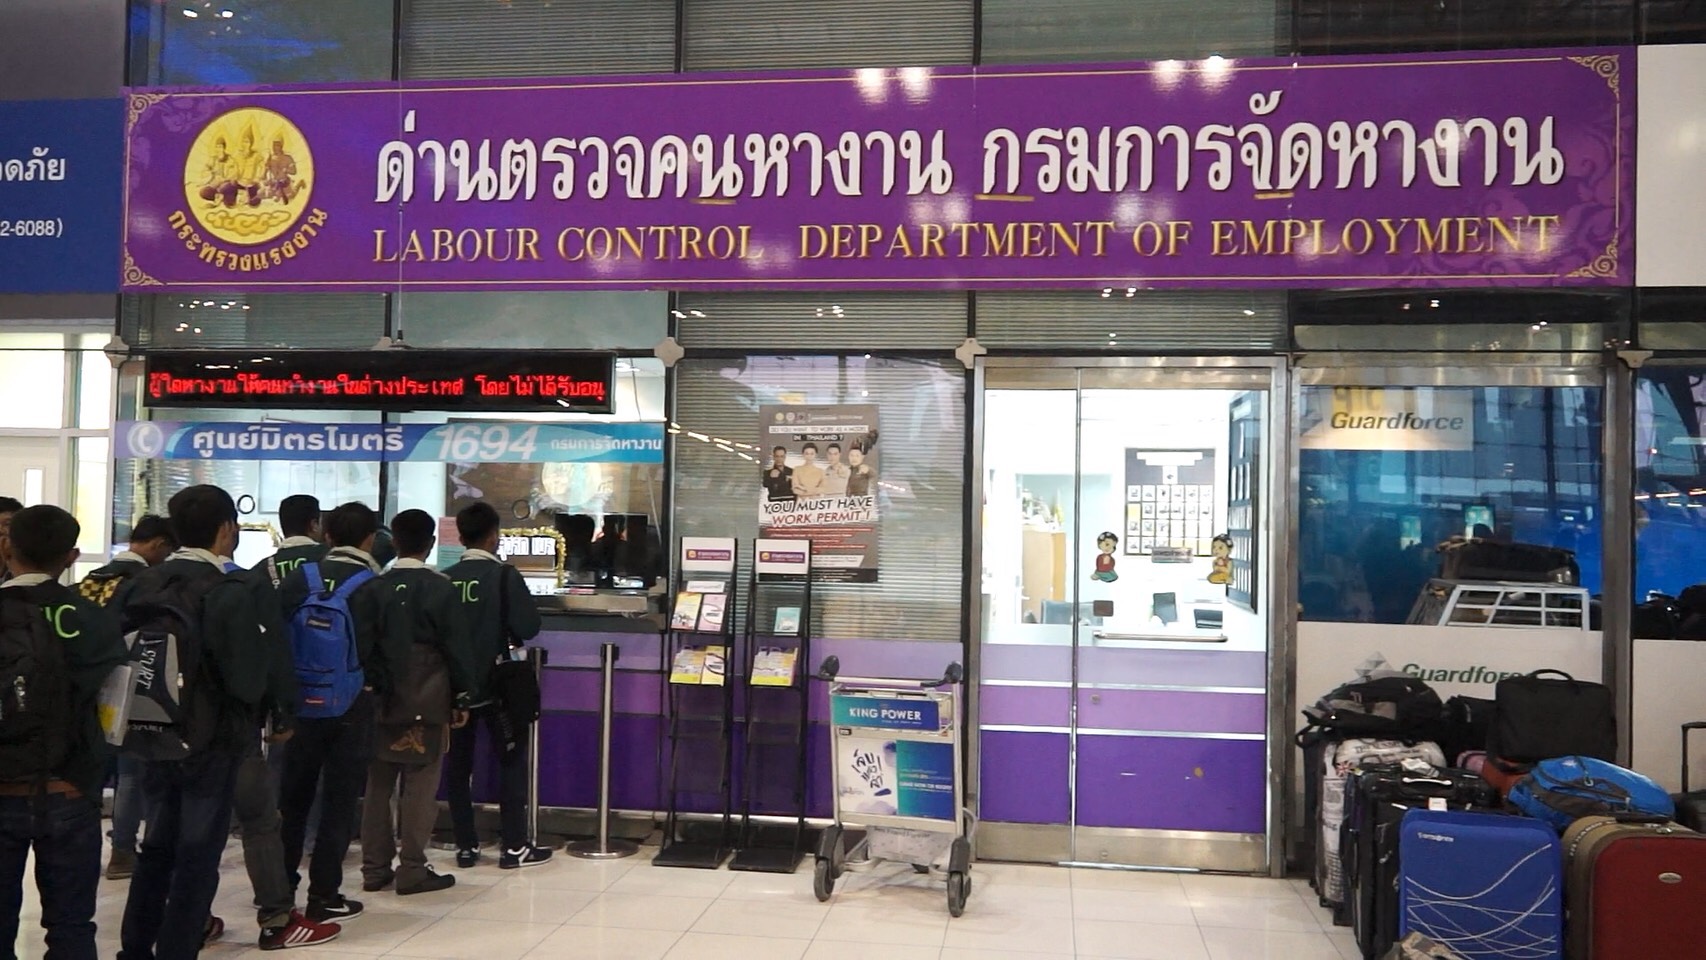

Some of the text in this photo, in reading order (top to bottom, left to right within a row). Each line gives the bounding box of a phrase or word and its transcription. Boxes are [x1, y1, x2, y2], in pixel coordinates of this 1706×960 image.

[374, 89, 1566, 205] ด่านตรวจคนหางาน กรมการจัดหางาน
[0, 146, 66, 181] ดภัย
[168, 208, 328, 272] กระทรวงแรงงาน
[373, 214, 1562, 264] LABOUR CONTROL DEPARTMENT OF EMPLOYMENT
[1330, 411, 1465, 431] Guardforce
[192, 423, 663, 461] ศูนย์มิตรไมตรี 1694 กรมการจัดหางาน
[763, 496, 873, 514] YOU MUST HAVE
[772, 513, 812, 525] WORK
[816, 511, 862, 522] PERMIT
[1402, 662, 1533, 684] Guardfor
[849, 707, 922, 721] KING POWER
